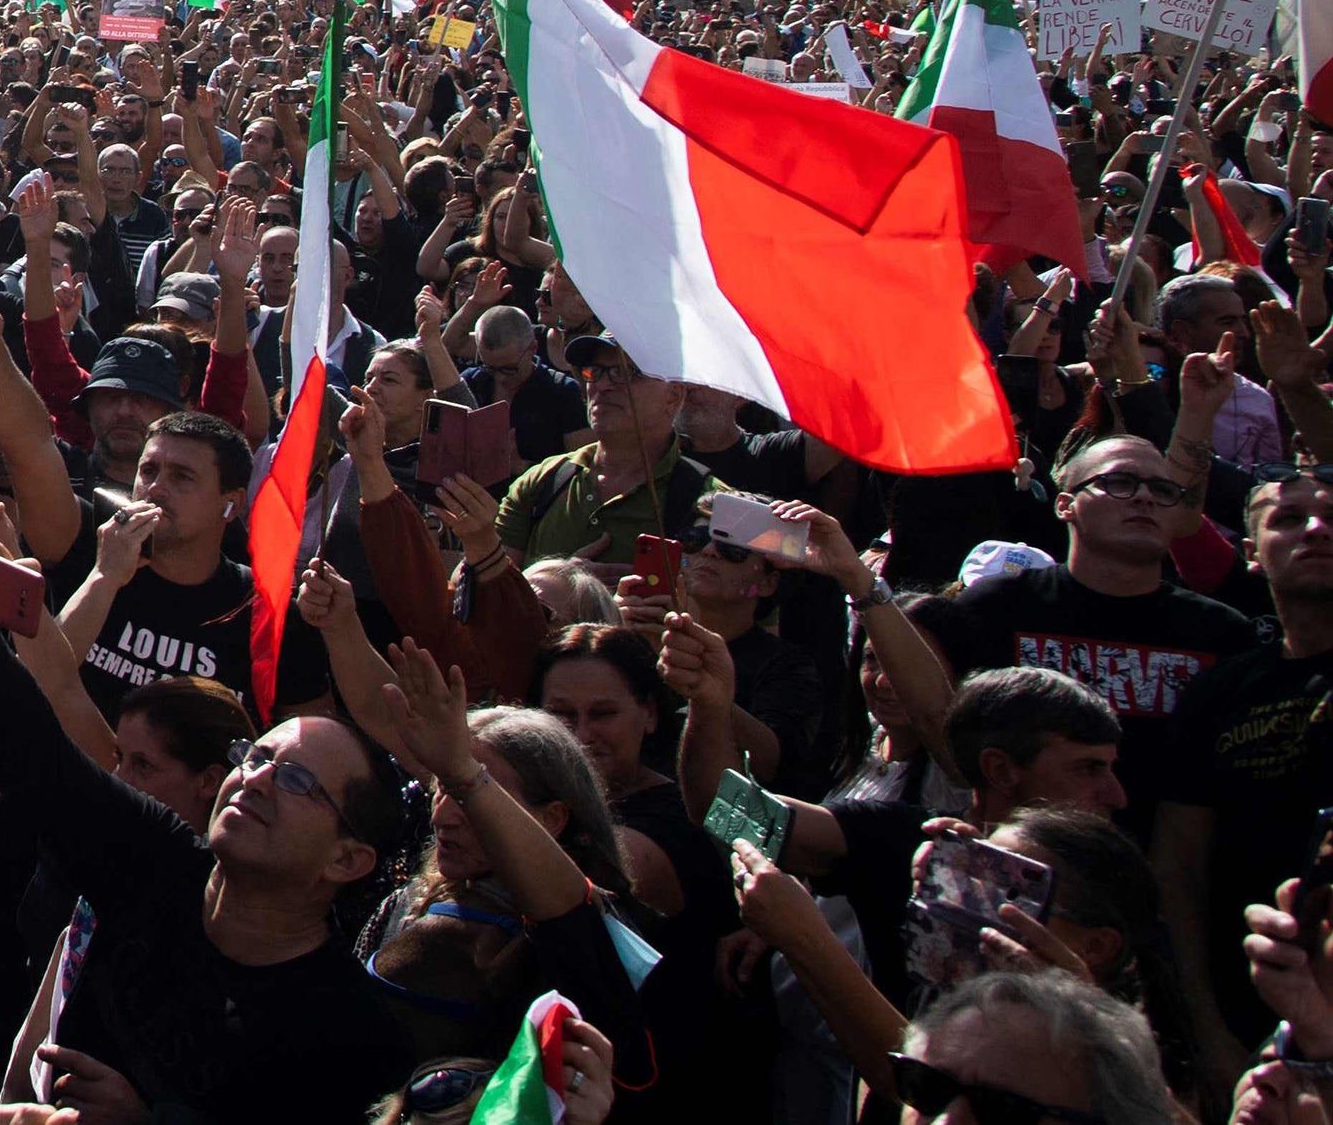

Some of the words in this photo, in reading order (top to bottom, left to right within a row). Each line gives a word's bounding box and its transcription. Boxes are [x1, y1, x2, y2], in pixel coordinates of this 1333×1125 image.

[1043, 8, 1100, 28] RENDE
[1243, 18, 1254, 28] IL
[100, 29, 111, 37] NO
[111, 30, 127, 38] ALLA
[804, 84, 846, 93] Repubblica
[117, 620, 217, 678] LOUIS
[85, 642, 156, 686] SEMPRE
[1019, 636, 1200, 714] MARVE
